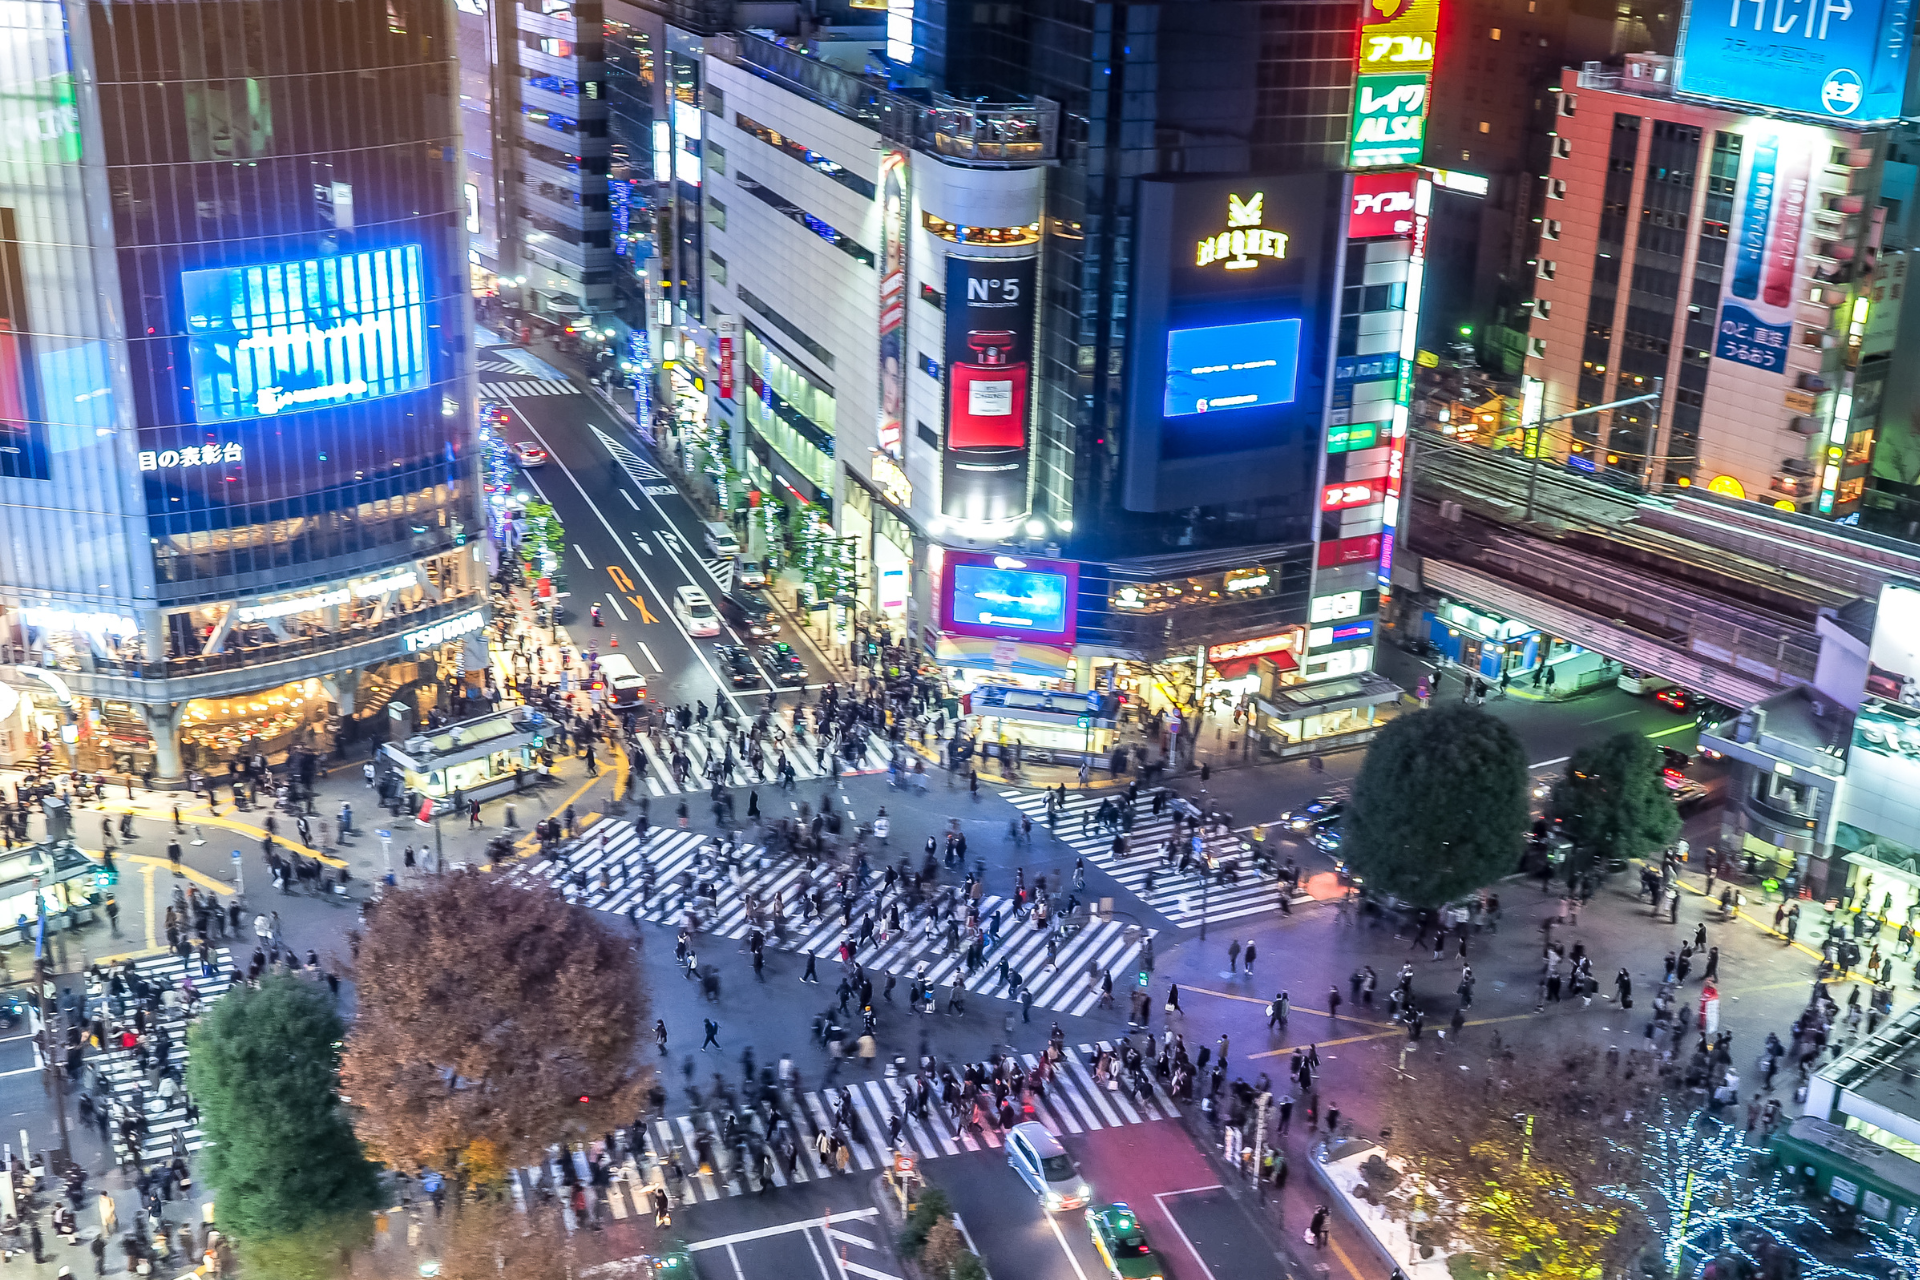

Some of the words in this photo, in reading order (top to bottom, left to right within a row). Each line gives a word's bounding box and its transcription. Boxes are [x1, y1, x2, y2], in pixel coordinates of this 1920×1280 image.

[1367, 36, 1433, 62] アコム
[1360, 84, 1425, 114] レイク
[1355, 115, 1422, 142] ALSA
[1723, 340, 1776, 366] うるおう
[138, 441, 243, 472] 目の表彰台
[403, 611, 485, 652] TSUTAYA
